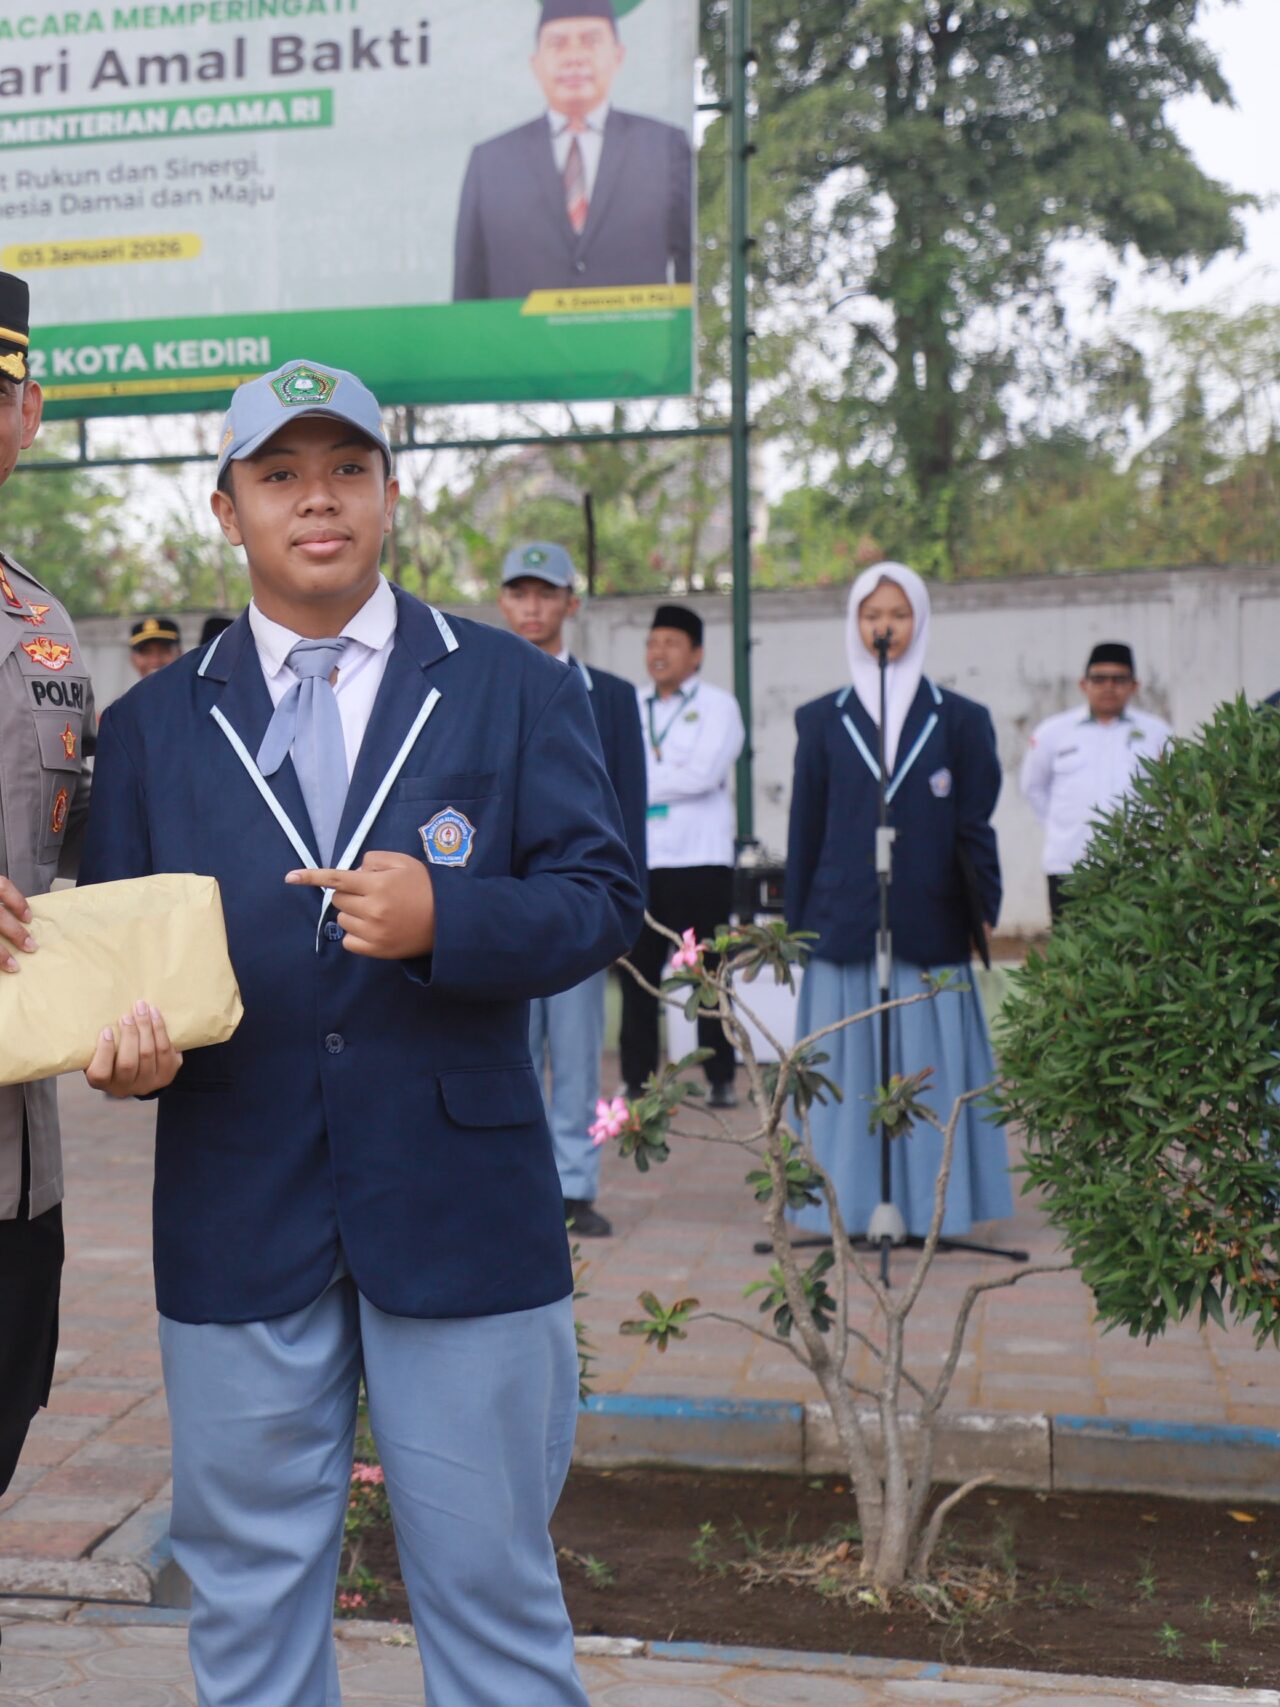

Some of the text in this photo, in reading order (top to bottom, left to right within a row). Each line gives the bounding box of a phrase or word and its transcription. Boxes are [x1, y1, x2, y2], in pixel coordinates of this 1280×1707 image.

[90, 37, 246, 90] Amal
[269, 20, 430, 76] Bakti
[172, 98, 287, 131] AGAMA
[291, 96, 320, 122] RI
[16, 165, 101, 190] Rukun
[106, 160, 157, 184] dan
[60, 186, 144, 215] Damai
[151, 187, 202, 208] dan
[209, 180, 275, 207] Maju
[51, 243, 124, 264] Januari
[52, 343, 149, 377] KOTA
[153, 337, 271, 369] KEDIRI
[31, 680, 84, 710] POLRI
